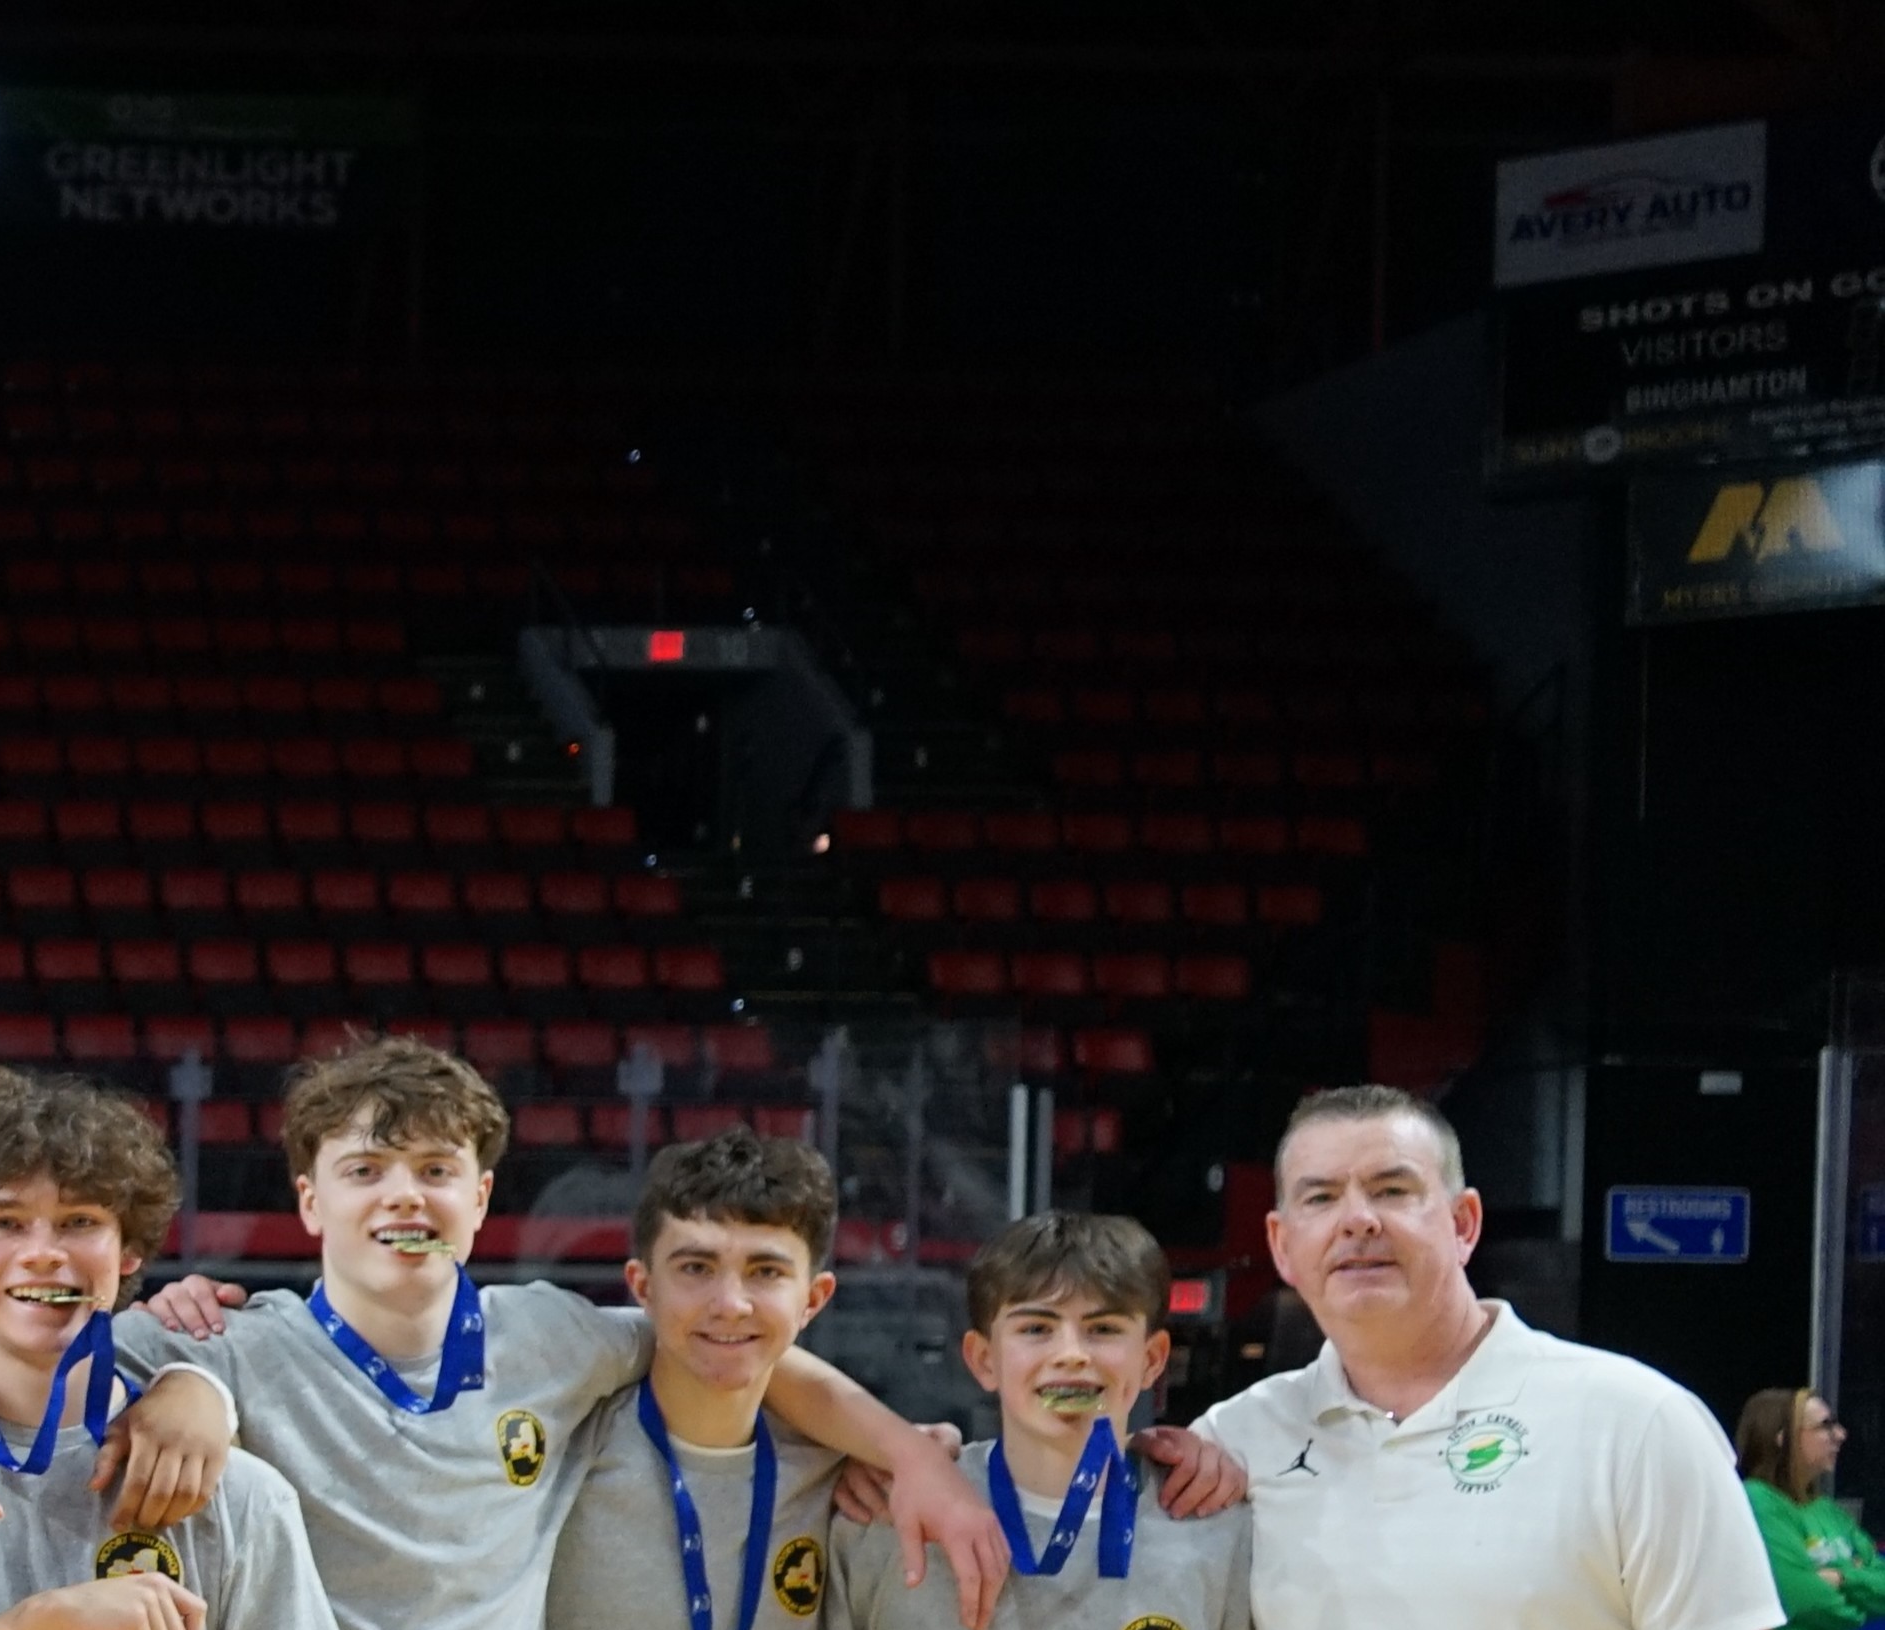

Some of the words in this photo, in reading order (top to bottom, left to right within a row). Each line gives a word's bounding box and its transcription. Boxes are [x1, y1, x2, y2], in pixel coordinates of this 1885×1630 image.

[44, 141, 359, 188] GREENLIGHT
[58, 182, 339, 226] NETWORKS
[1509, 202, 1631, 242] AVERY
[1647, 180, 1753, 222] AUTO
[1577, 289, 1732, 333] SHOTS
[1745, 277, 1814, 310] ON
[1620, 318, 1789, 368] VISITORS
[1624, 365, 1808, 415] BINGHAMTON
